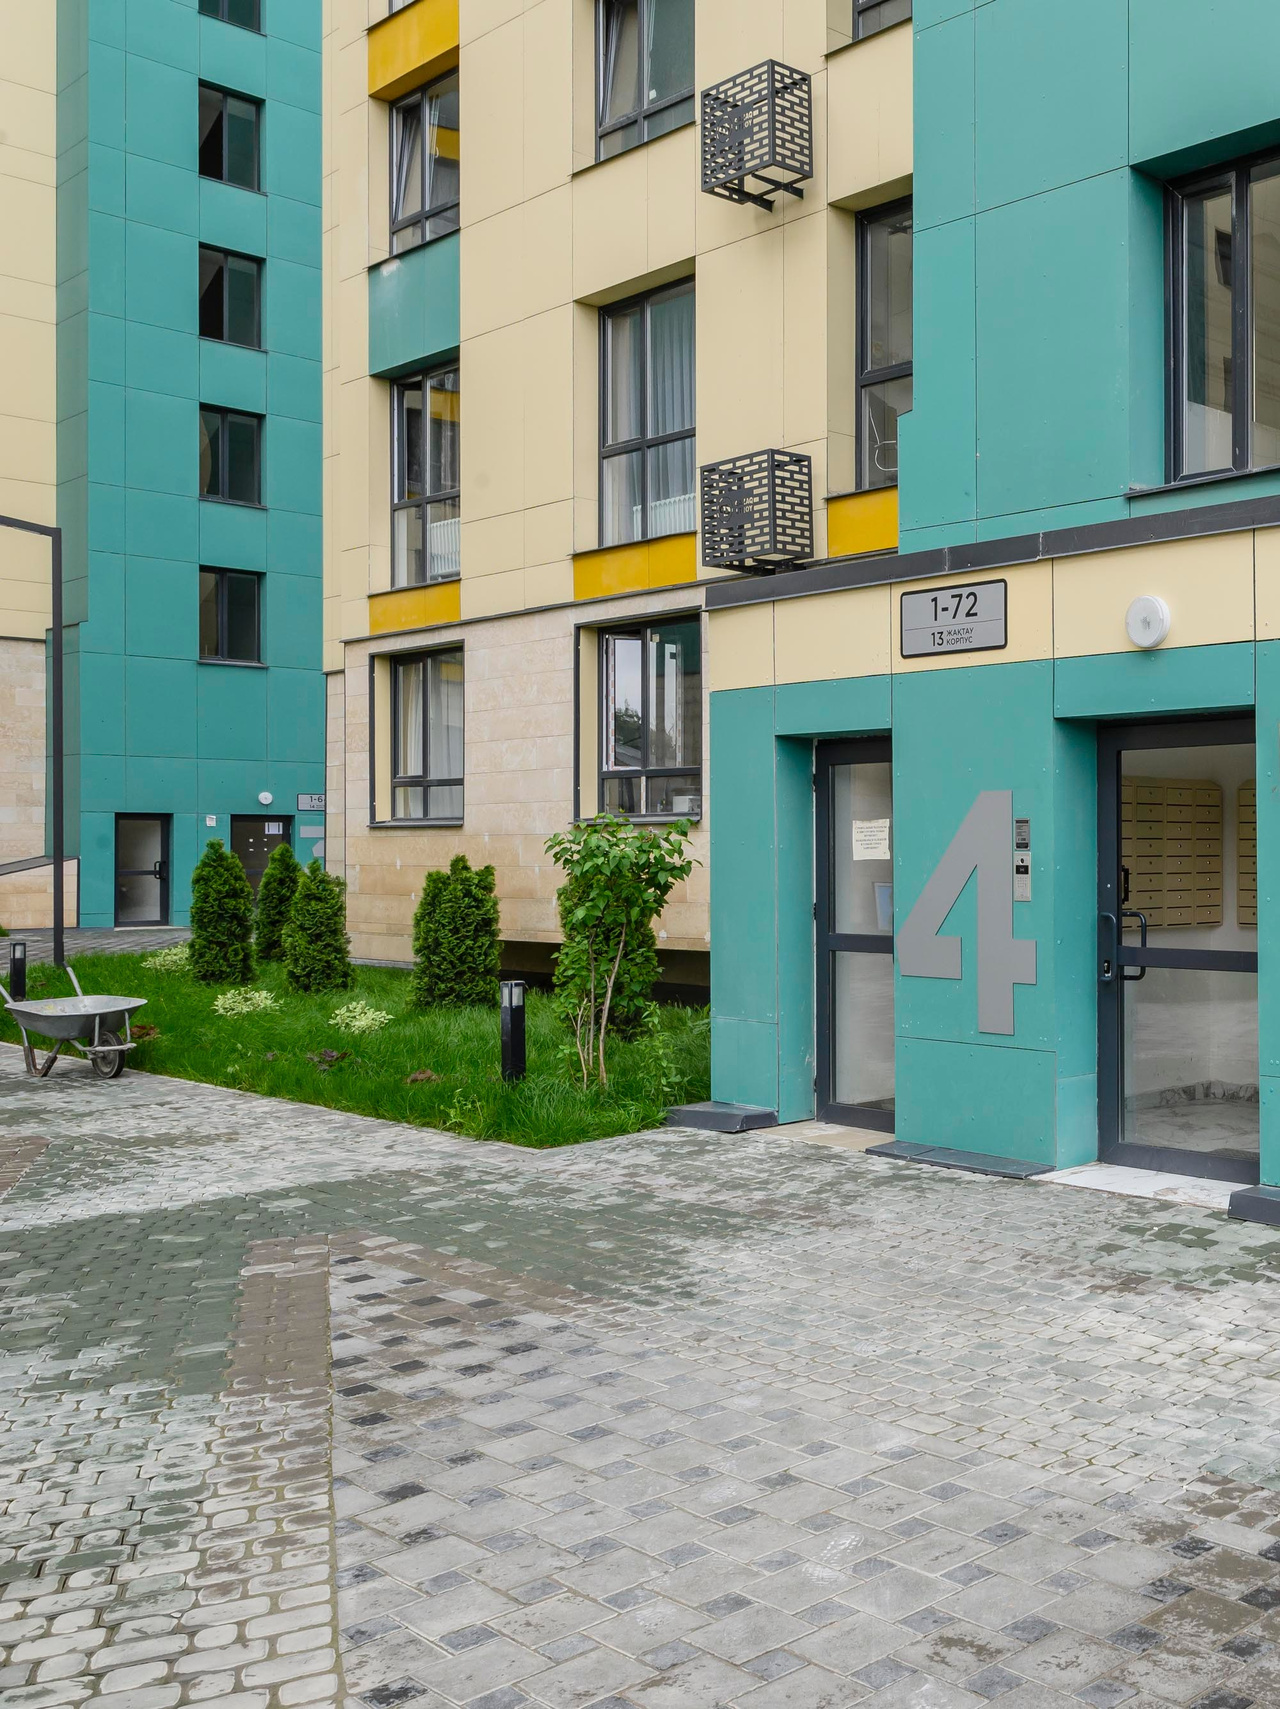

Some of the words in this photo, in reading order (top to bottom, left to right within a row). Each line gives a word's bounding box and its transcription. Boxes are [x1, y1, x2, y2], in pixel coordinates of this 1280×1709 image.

[930, 591, 978, 621] 1-72
[930, 631, 944, 647] 13
[946, 635, 973, 646] КОРПУС
[896, 790, 1037, 1036] 4
